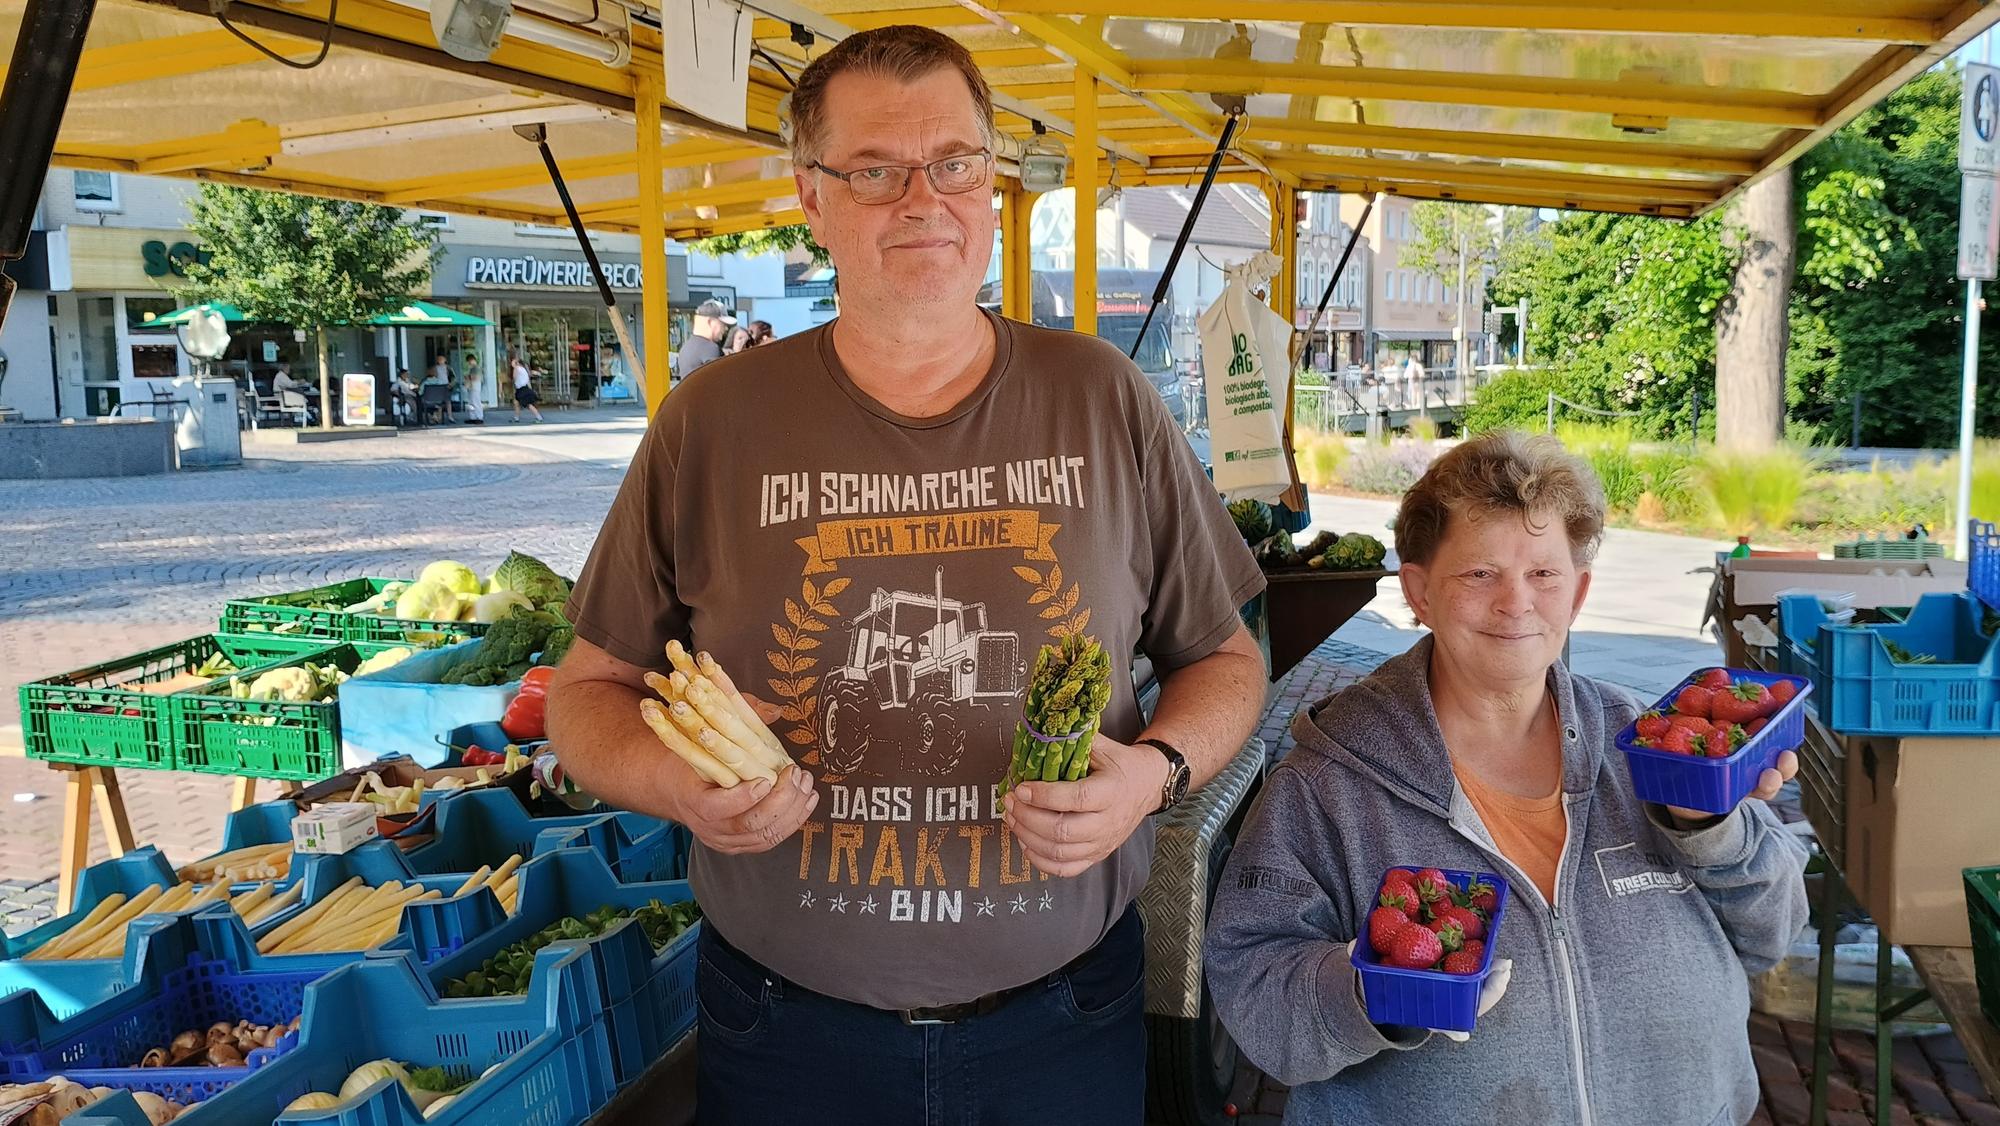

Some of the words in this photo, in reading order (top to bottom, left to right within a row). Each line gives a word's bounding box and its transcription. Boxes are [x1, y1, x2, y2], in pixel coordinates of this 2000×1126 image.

[470, 255, 593, 286] PARFÜMERIE
[1225, 391, 1256, 405] biologisch
[760, 472, 810, 527] ICH
[820, 465, 998, 515] SCHNARCHE
[1005, 455, 1085, 508] NICHT
[845, 525, 894, 555] ICH
[904, 516, 1013, 550] TRÄUME
[830, 784, 913, 822] DASS
[925, 784, 979, 822] ICH
[797, 822, 1049, 888] TRAKTO
[1612, 872, 1653, 892] STREET
[889, 890, 963, 922] BIN
